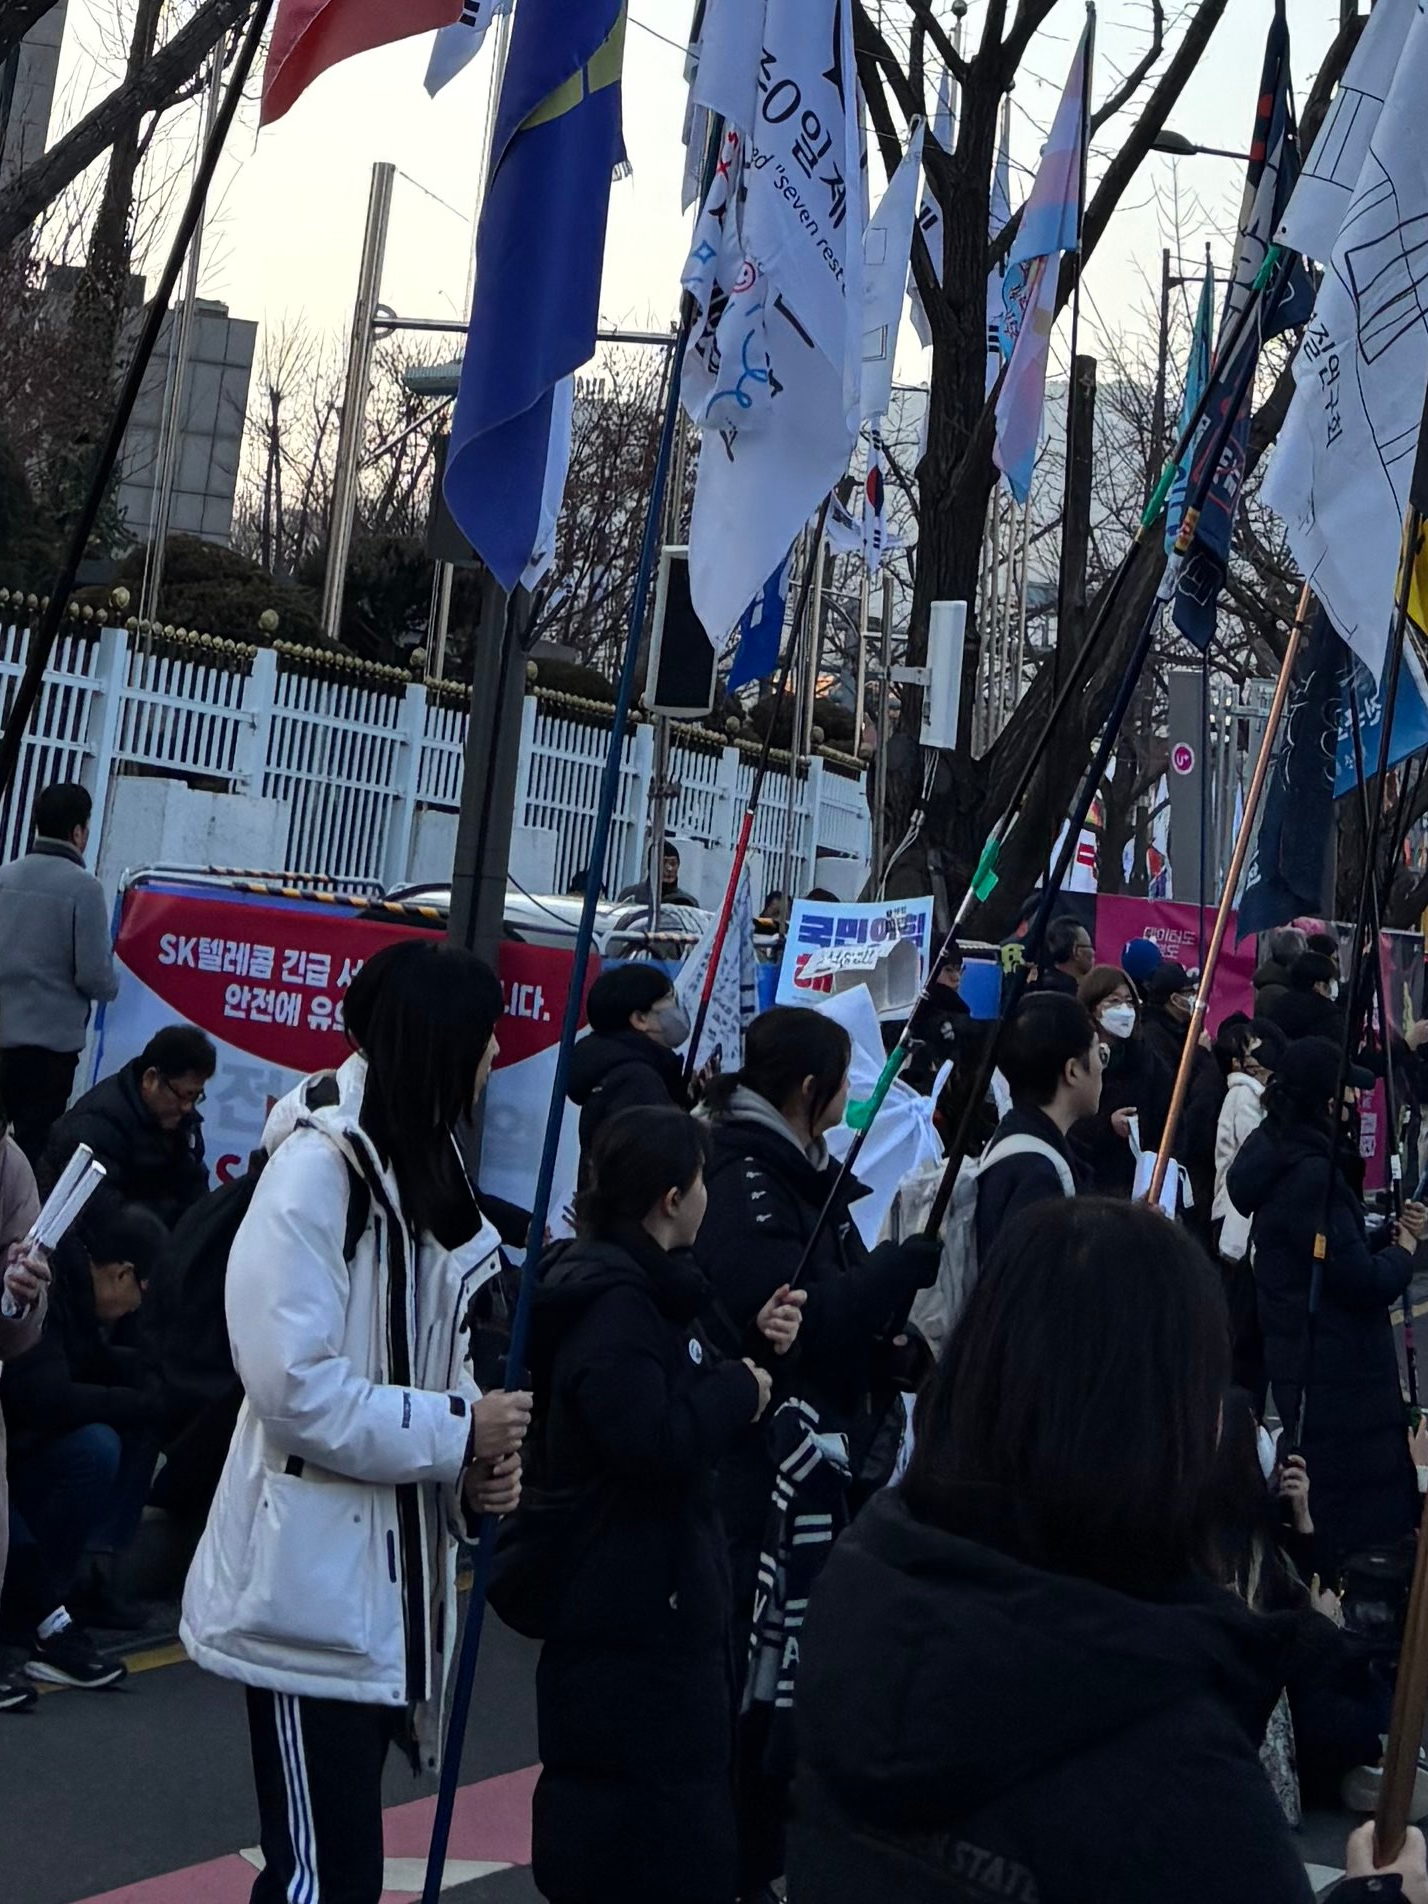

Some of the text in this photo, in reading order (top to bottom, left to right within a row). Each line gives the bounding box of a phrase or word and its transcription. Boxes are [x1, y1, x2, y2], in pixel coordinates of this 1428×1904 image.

[158, 932, 363, 989] SK텔레콤 긴급 서
[223, 982, 302, 1027] 안전에
